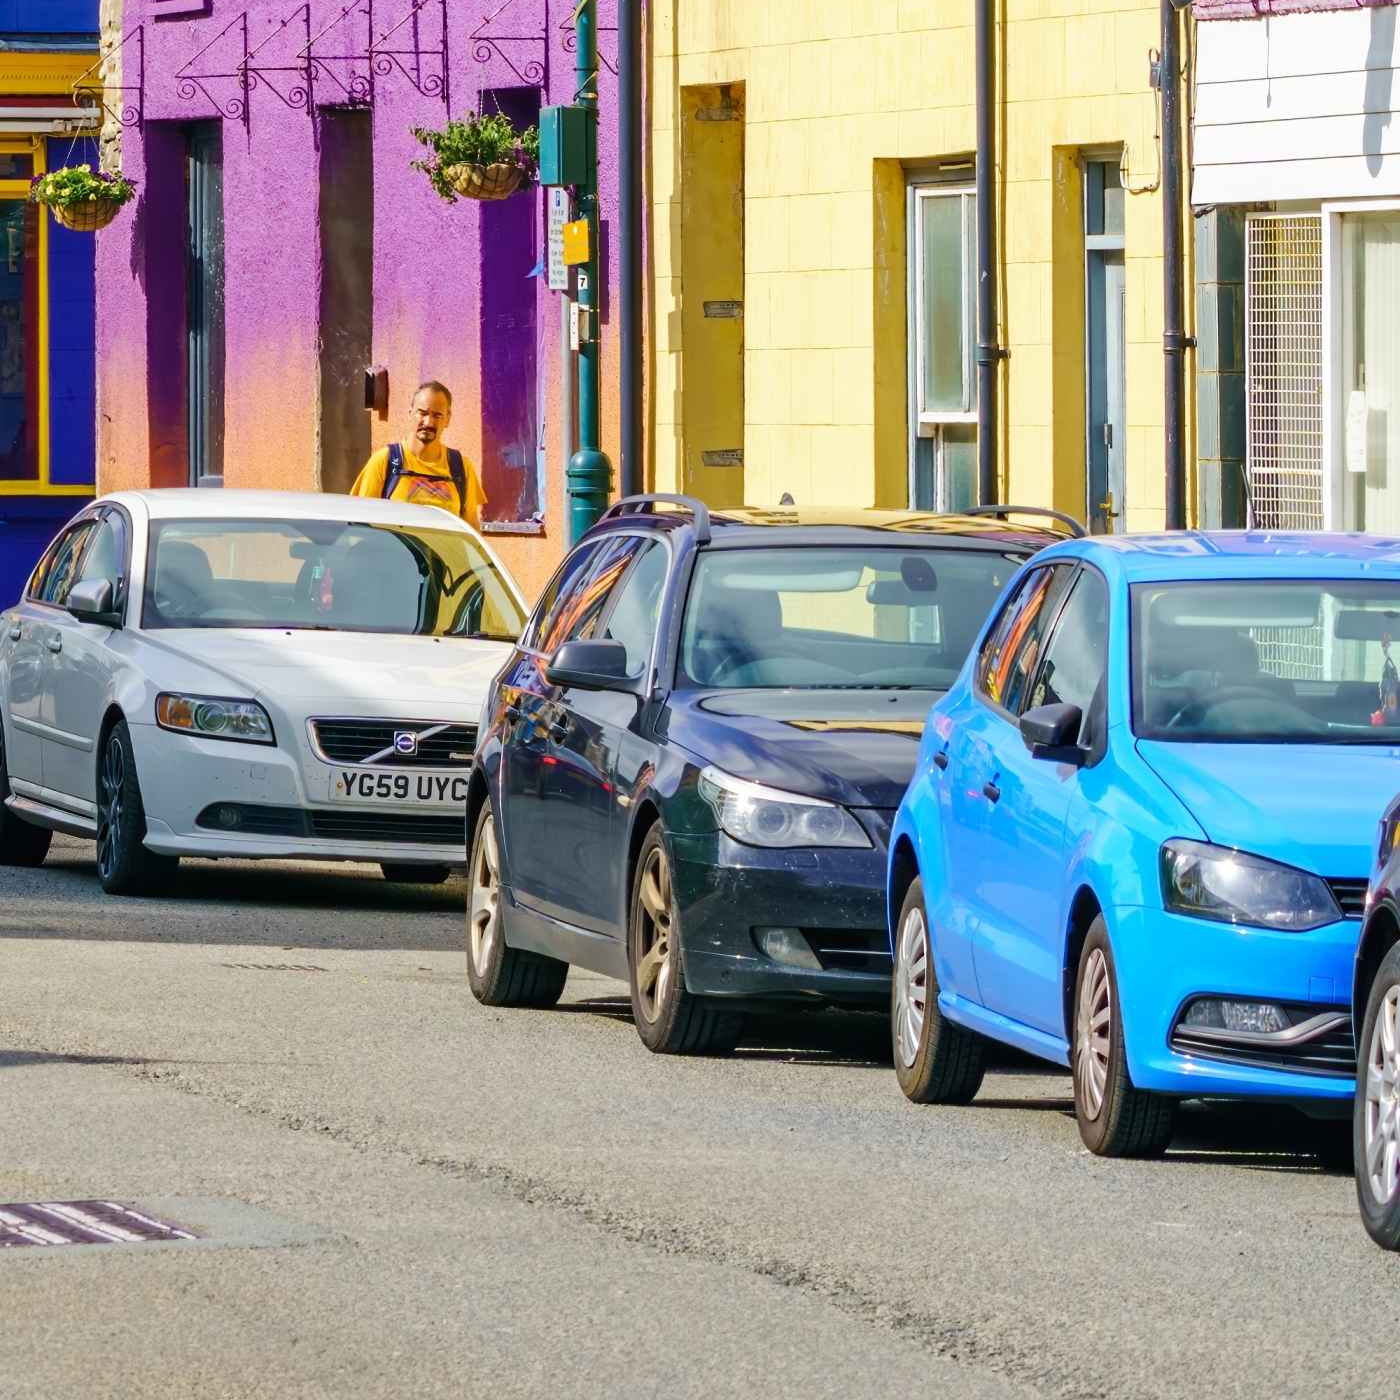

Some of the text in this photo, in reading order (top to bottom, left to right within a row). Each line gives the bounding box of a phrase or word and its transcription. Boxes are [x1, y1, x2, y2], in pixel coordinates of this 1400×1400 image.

[579, 277, 586, 287] 7
[342, 772, 468, 801] YG59 UYC
